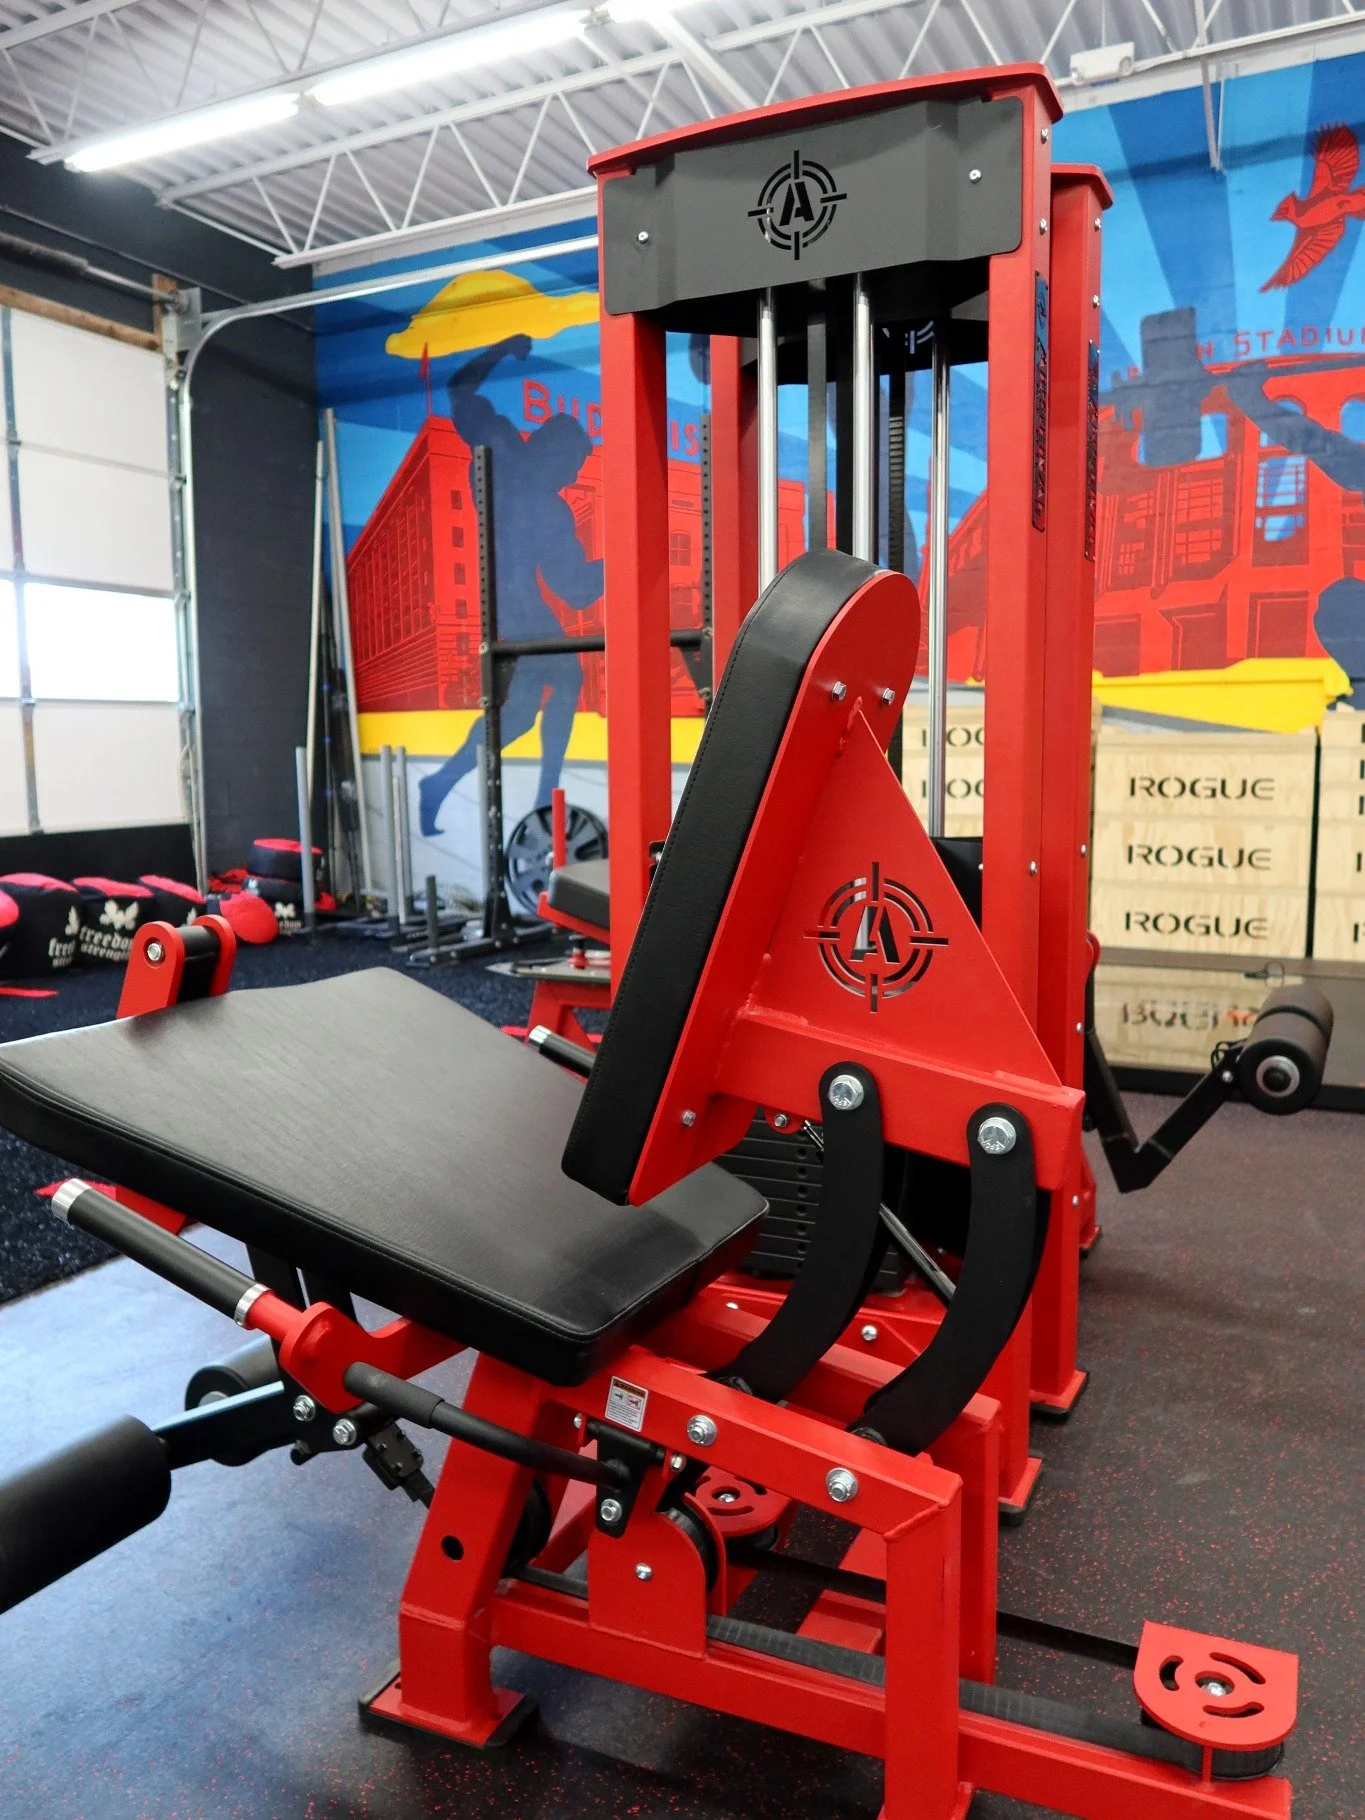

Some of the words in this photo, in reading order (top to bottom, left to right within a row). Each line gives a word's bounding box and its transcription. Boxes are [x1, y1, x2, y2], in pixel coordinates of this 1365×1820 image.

[1234, 326, 1365, 357] STADIU
[1130, 776, 1275, 800] ROGUE
[1127, 844, 1271, 870] ROGUE
[79, 925, 133, 950] freedo
[1125, 911, 1268, 939] ROGUE
